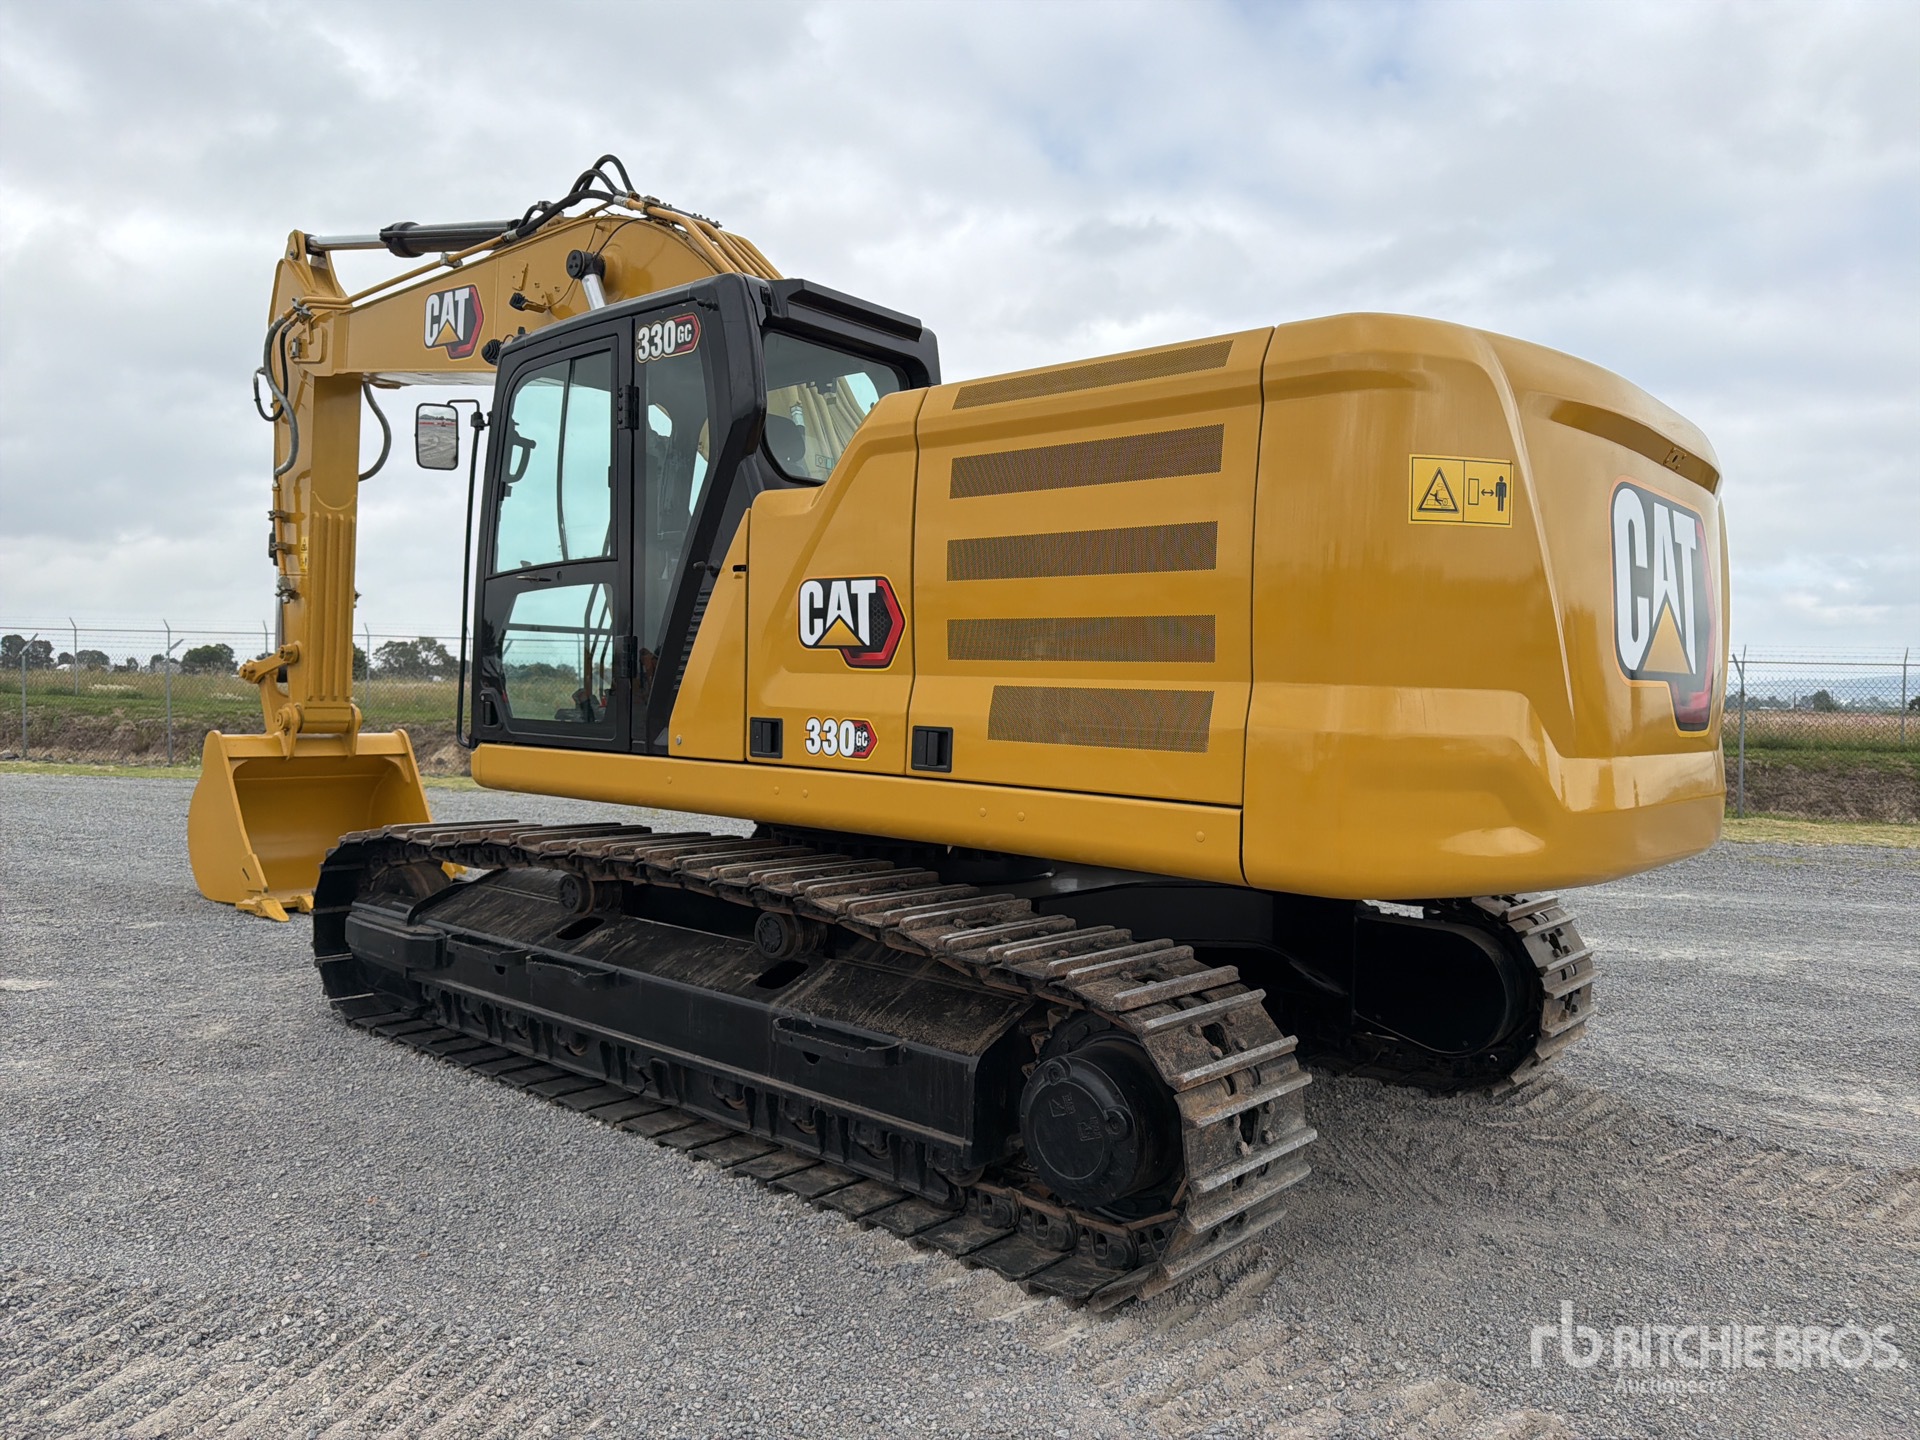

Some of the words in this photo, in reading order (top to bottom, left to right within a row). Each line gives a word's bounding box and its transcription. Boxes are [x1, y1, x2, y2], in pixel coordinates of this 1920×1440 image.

[424, 287, 470, 347] CAT
[800, 579, 876, 646] CAT
[1613, 487, 1697, 675] CAT
